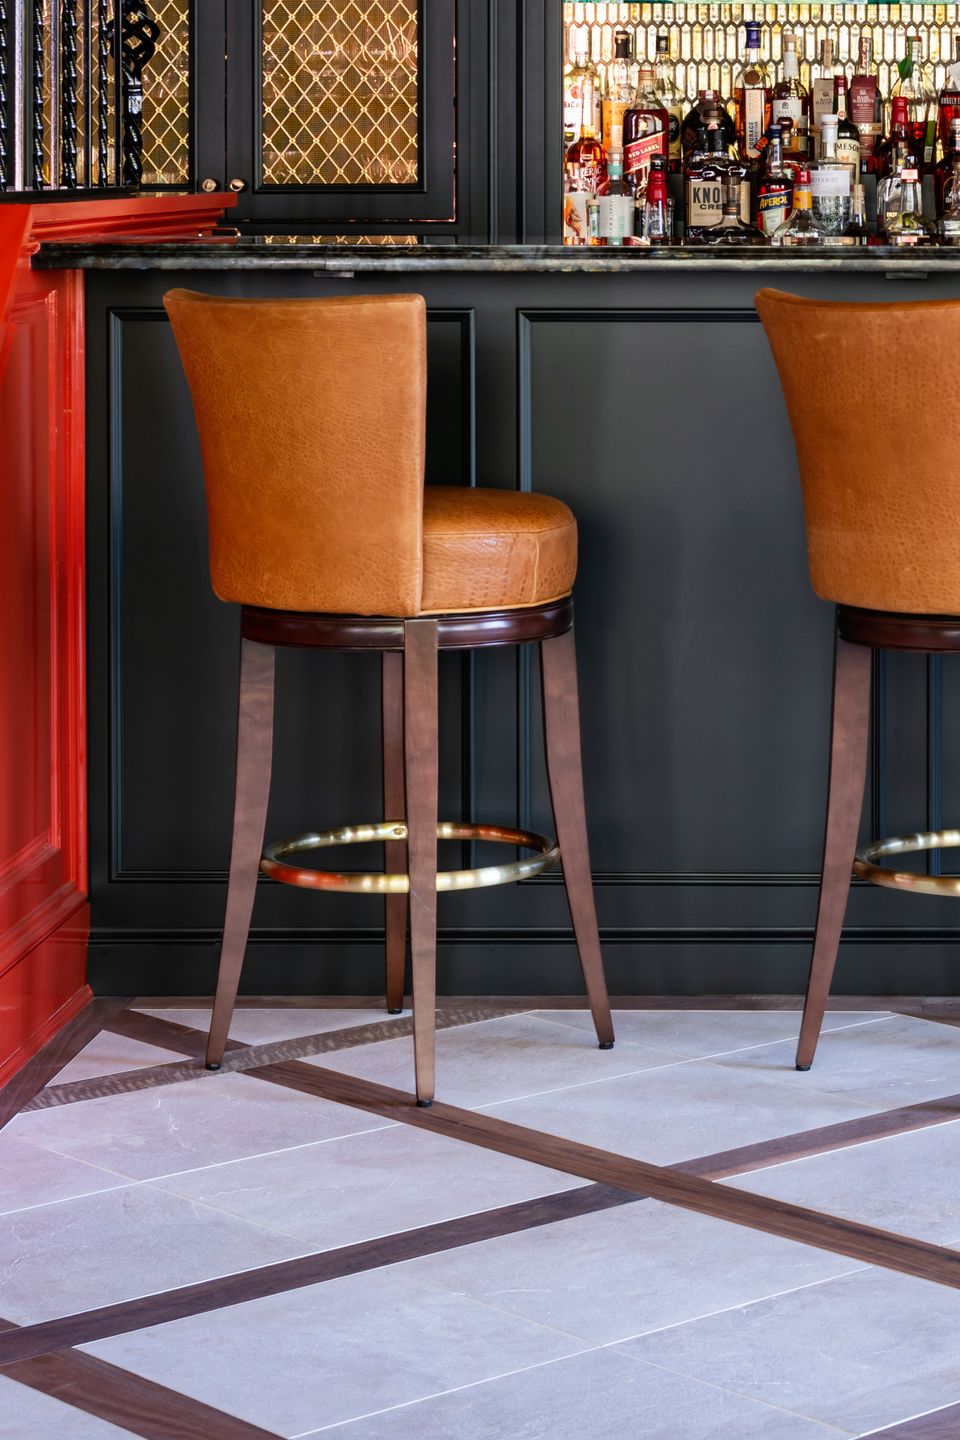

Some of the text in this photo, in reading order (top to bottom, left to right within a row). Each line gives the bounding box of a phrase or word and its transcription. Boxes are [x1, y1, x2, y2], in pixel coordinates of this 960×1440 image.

[628, 143, 660, 158] RED LABEL
[693, 187, 721, 204] KNO
[760, 195, 788, 210] APEROL
